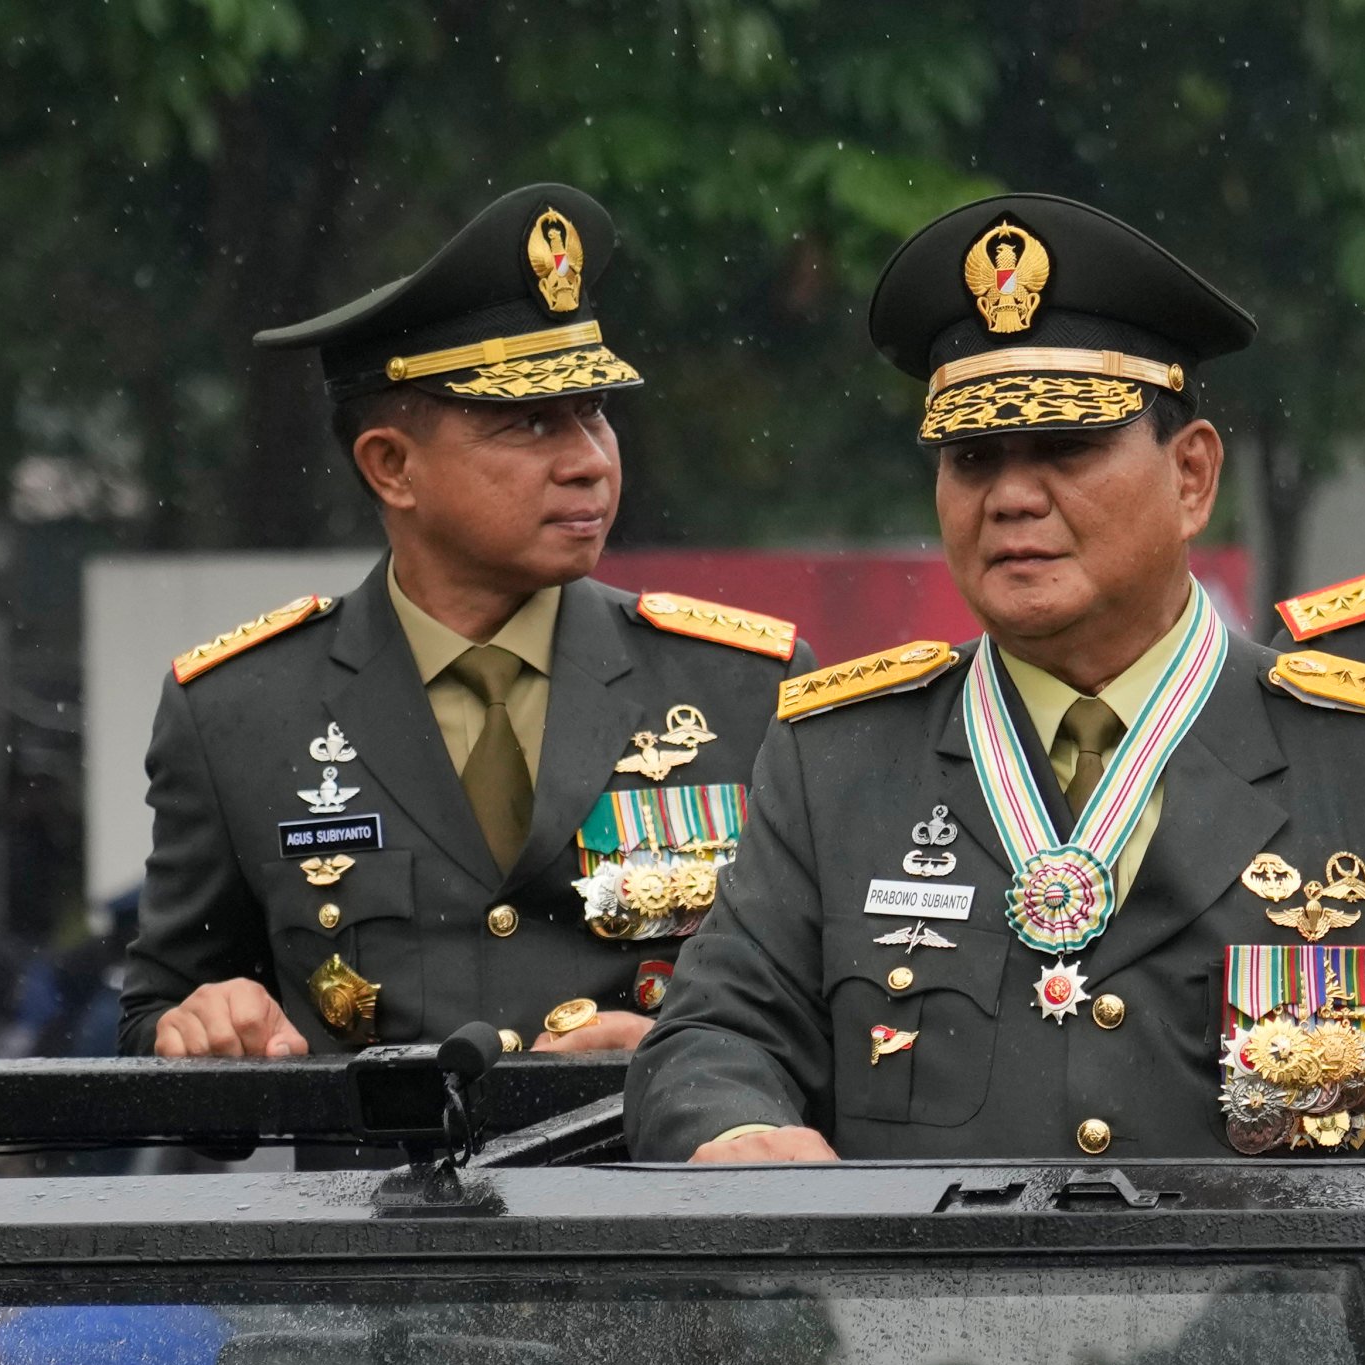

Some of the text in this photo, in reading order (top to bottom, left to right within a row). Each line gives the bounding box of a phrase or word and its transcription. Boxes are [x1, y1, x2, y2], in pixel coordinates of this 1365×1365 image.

[287, 826, 371, 846] AGUS SUBIYANTO
[870, 889, 968, 910] PRABOWO SUBIANTO
